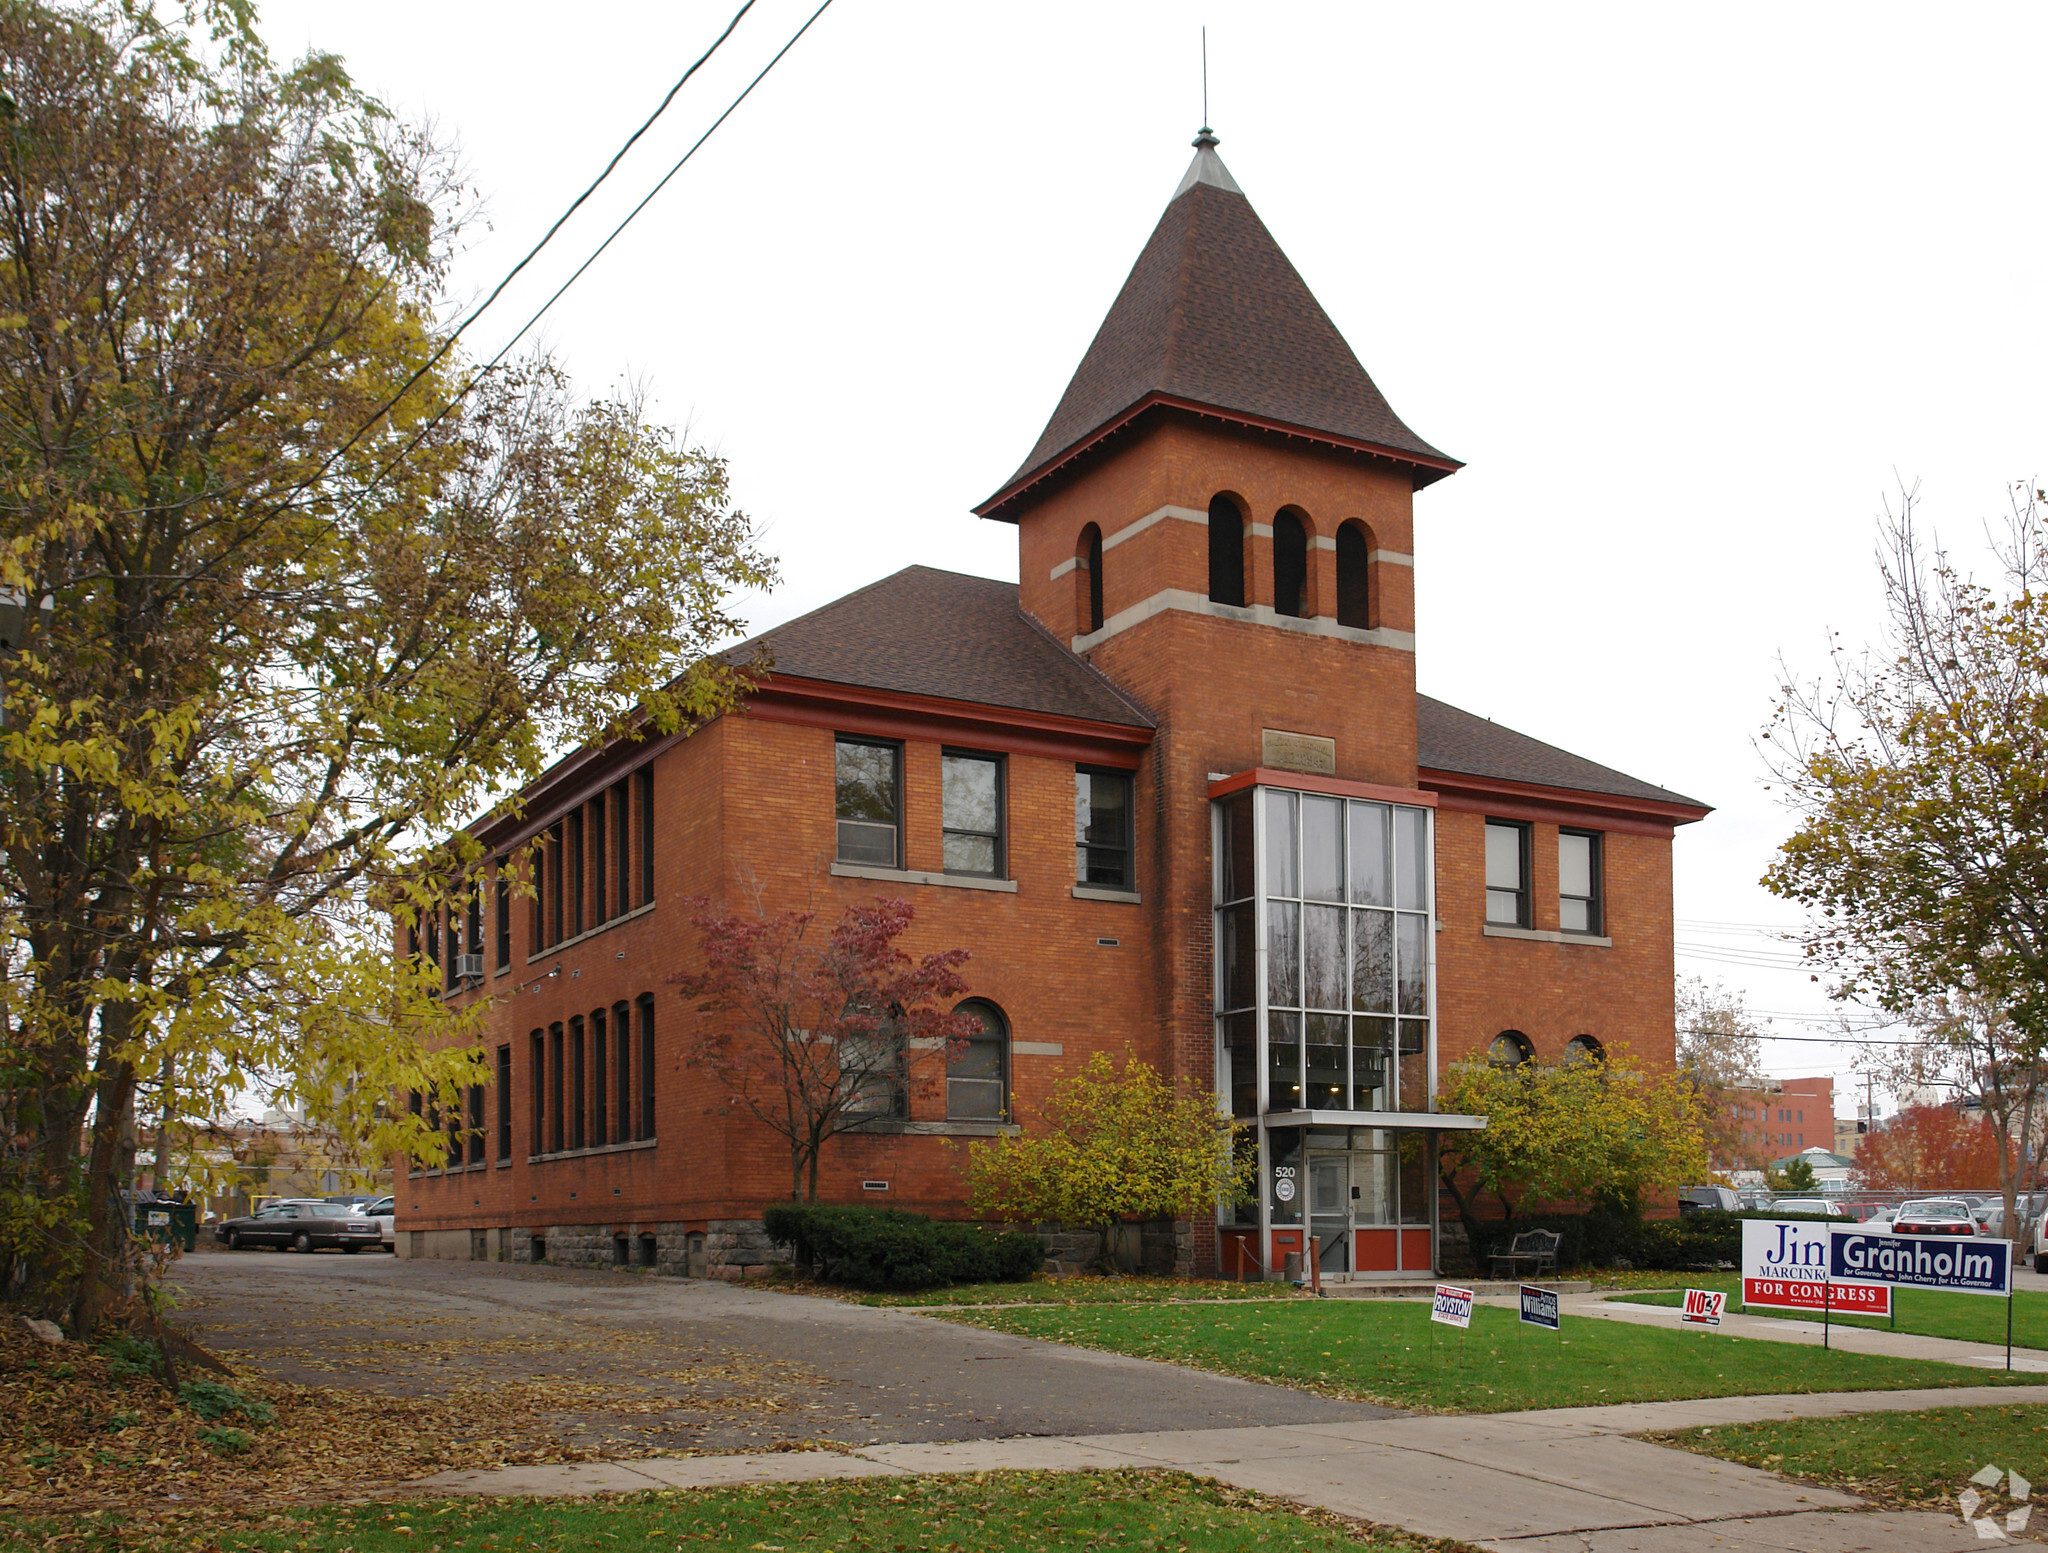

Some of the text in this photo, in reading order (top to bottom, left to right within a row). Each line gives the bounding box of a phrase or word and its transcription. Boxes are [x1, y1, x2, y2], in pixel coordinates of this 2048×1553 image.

[1275, 1166, 1296, 1178] 520
[1878, 1238, 1902, 1248] Jennifer
[1842, 1235, 1994, 1279] Granholm
[1759, 1265, 1826, 1281] MARCINK
[1843, 1267, 1993, 1288] for Governor John Cherry for Lt. Governor
[1540, 1291, 1556, 1306] Amos
[1754, 1281, 1876, 1303] FOR CONGRESS
[1434, 1294, 1471, 1317] ROYSTON
[1522, 1294, 1557, 1319] Williams
[1686, 1290, 1722, 1316] NO 2
